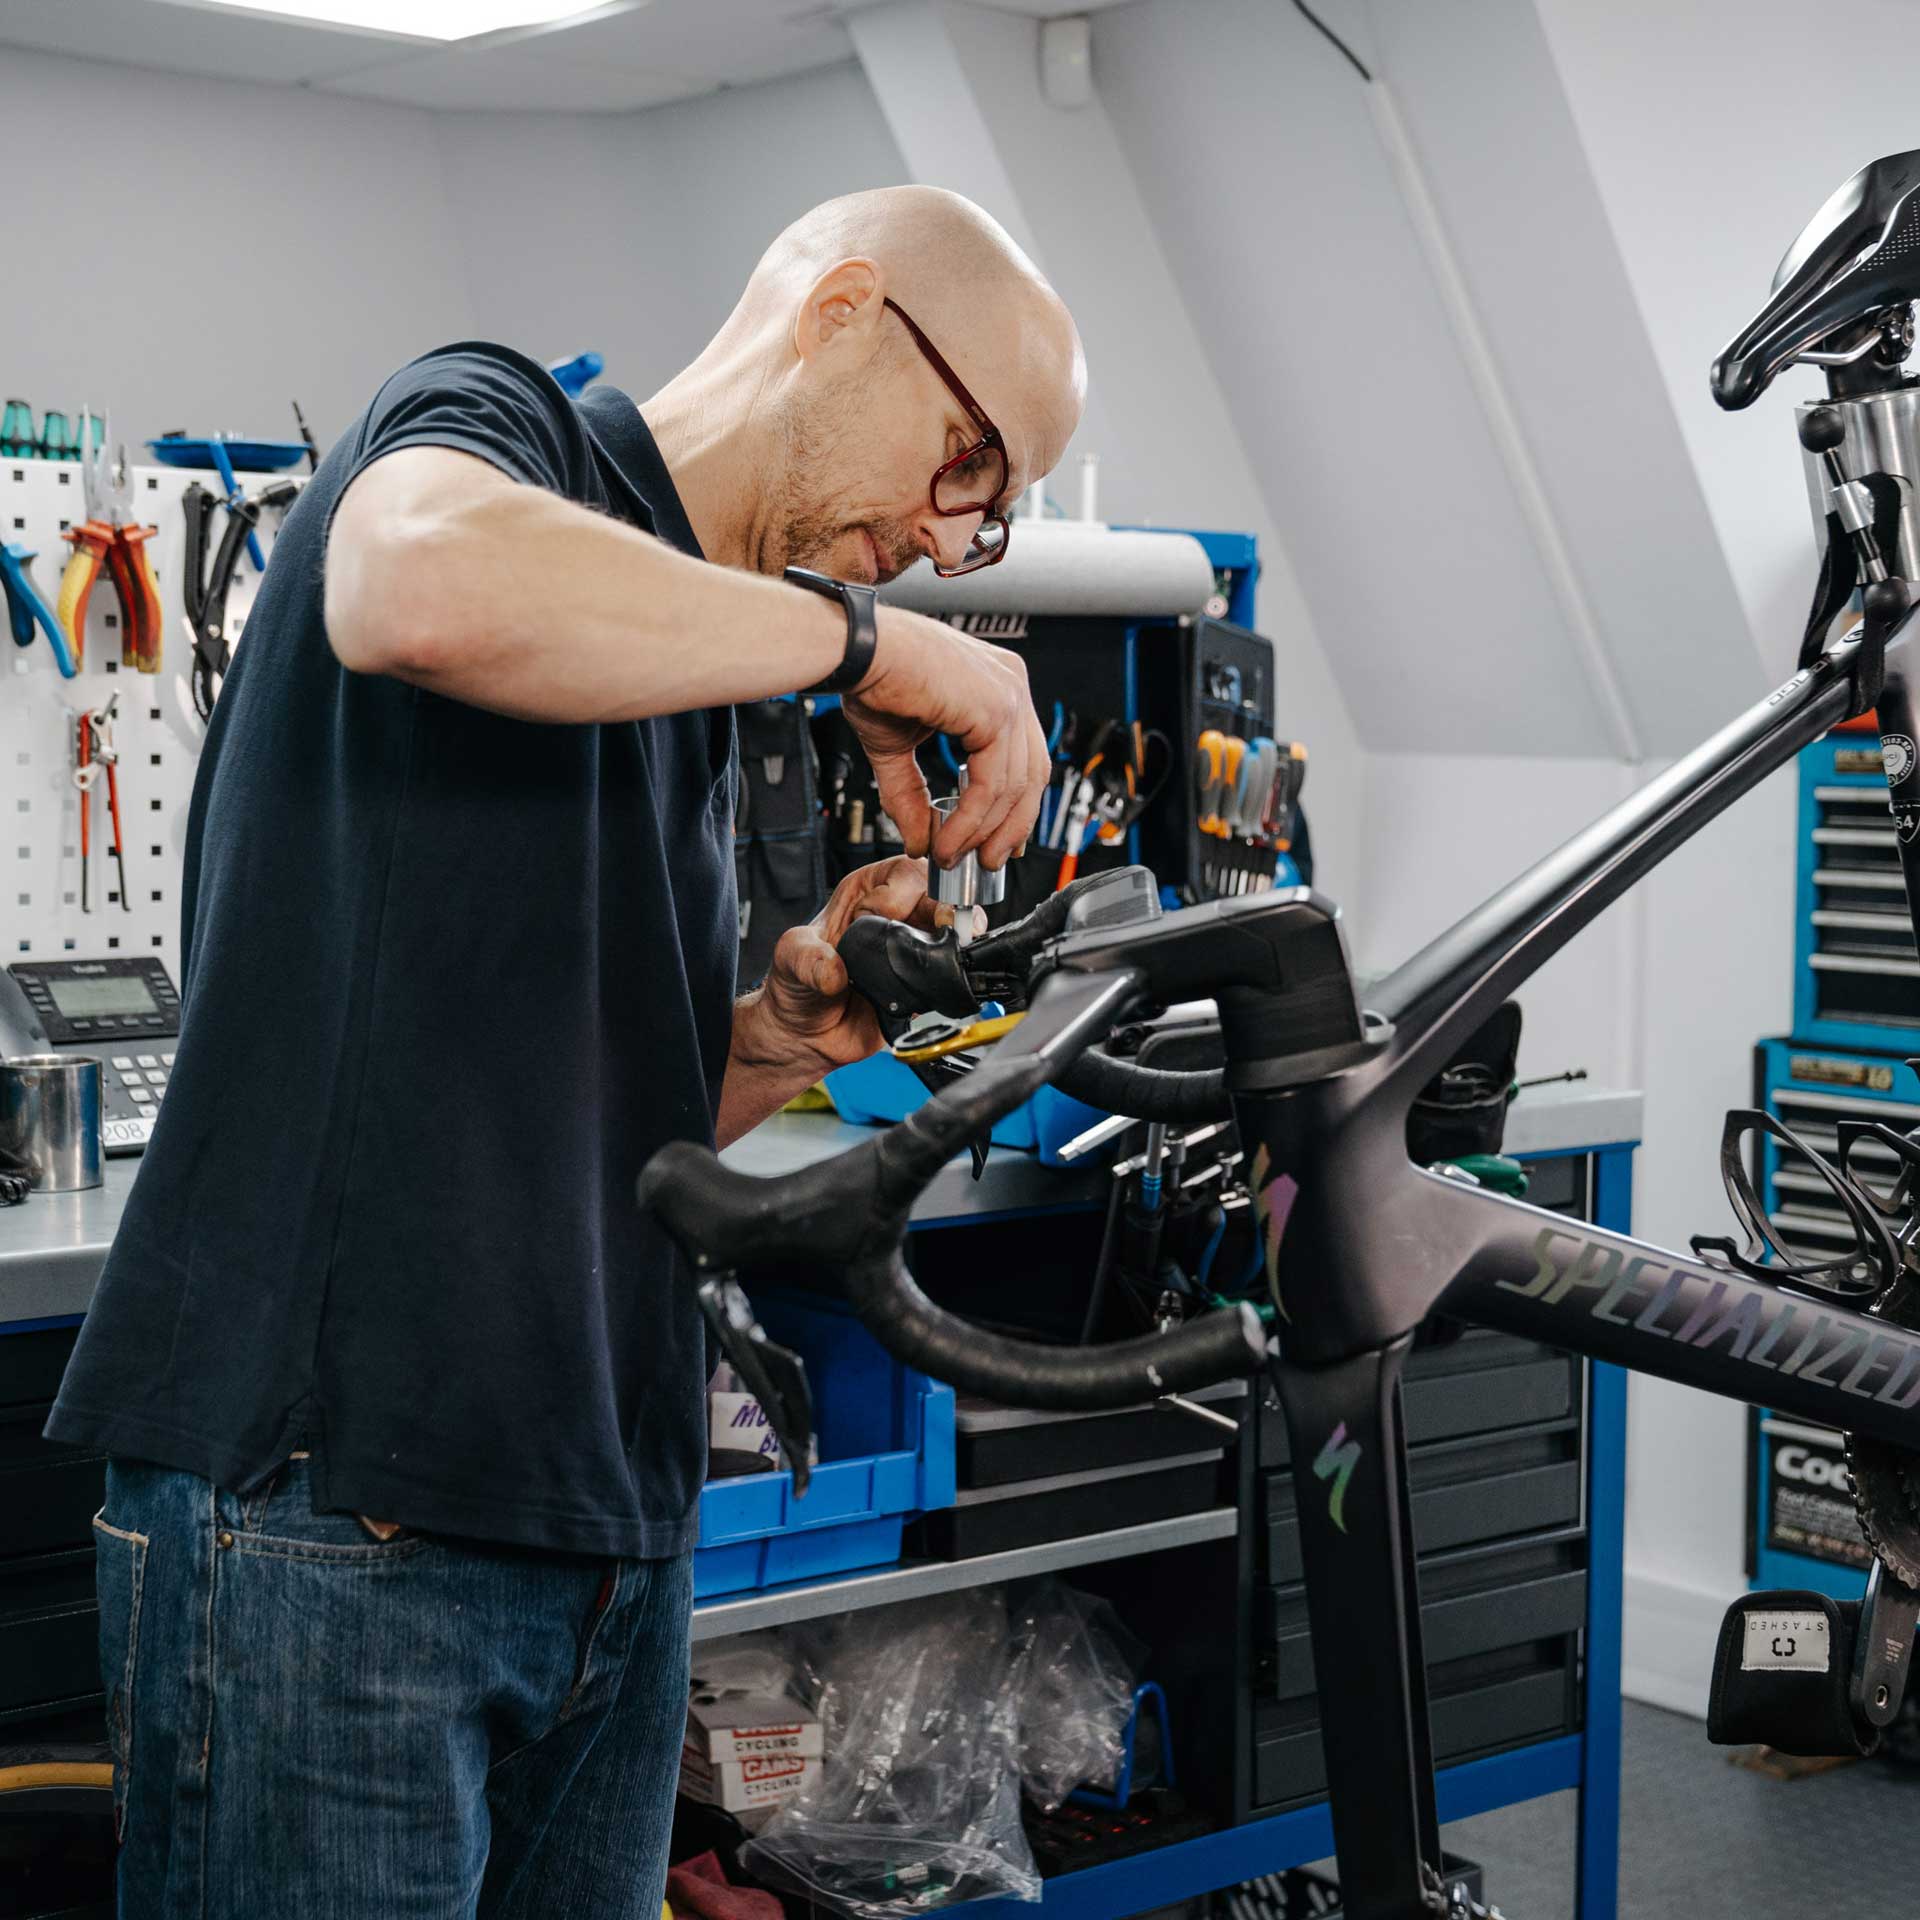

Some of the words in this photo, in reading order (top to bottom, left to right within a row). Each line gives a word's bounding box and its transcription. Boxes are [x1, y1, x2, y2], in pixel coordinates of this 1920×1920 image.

[1895, 814, 1915, 829] 54
[1496, 1227, 1920, 1409] SPECIALIZED
[1750, 1621, 1824, 1632] STASHED
[735, 1737, 799, 1751] CYCLING
[744, 1775, 801, 1795] CYCLING
